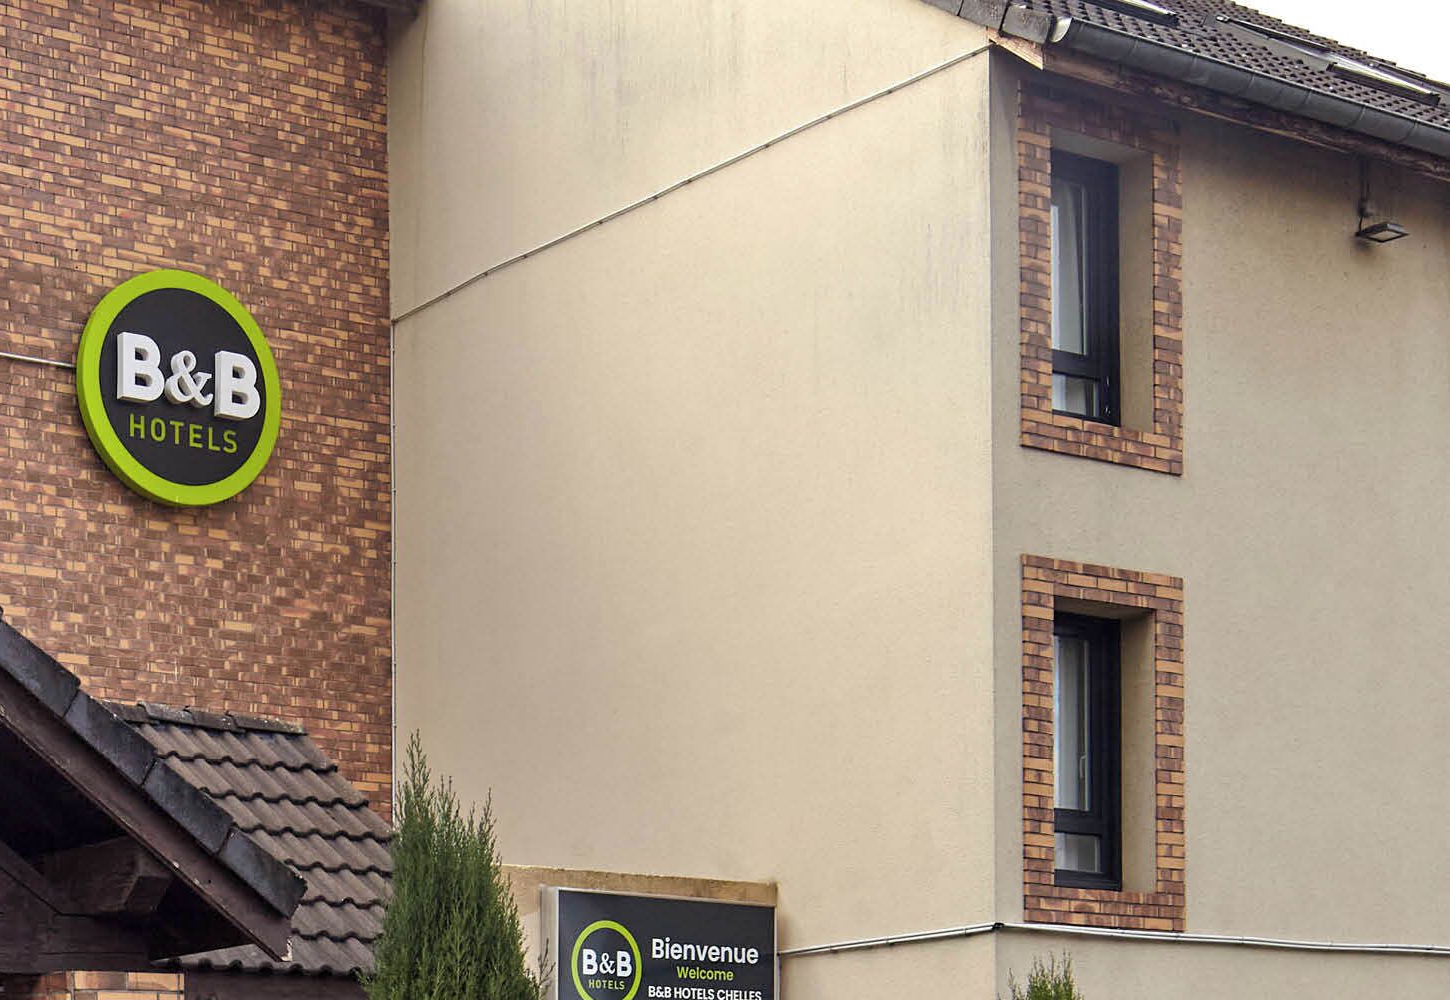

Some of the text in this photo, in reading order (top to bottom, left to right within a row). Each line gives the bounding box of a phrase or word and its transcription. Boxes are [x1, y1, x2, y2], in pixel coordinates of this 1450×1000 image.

[117, 332, 261, 419] B&B
[129, 413, 238, 453] HOTELS
[582, 949, 632, 977] B&B
[652, 937, 759, 964] Bienvenue
[588, 979, 625, 990] HOTELS
[676, 966, 734, 981] Welcome
[648, 986, 671, 999] B&B
[674, 987, 715, 1000] HOTELS
